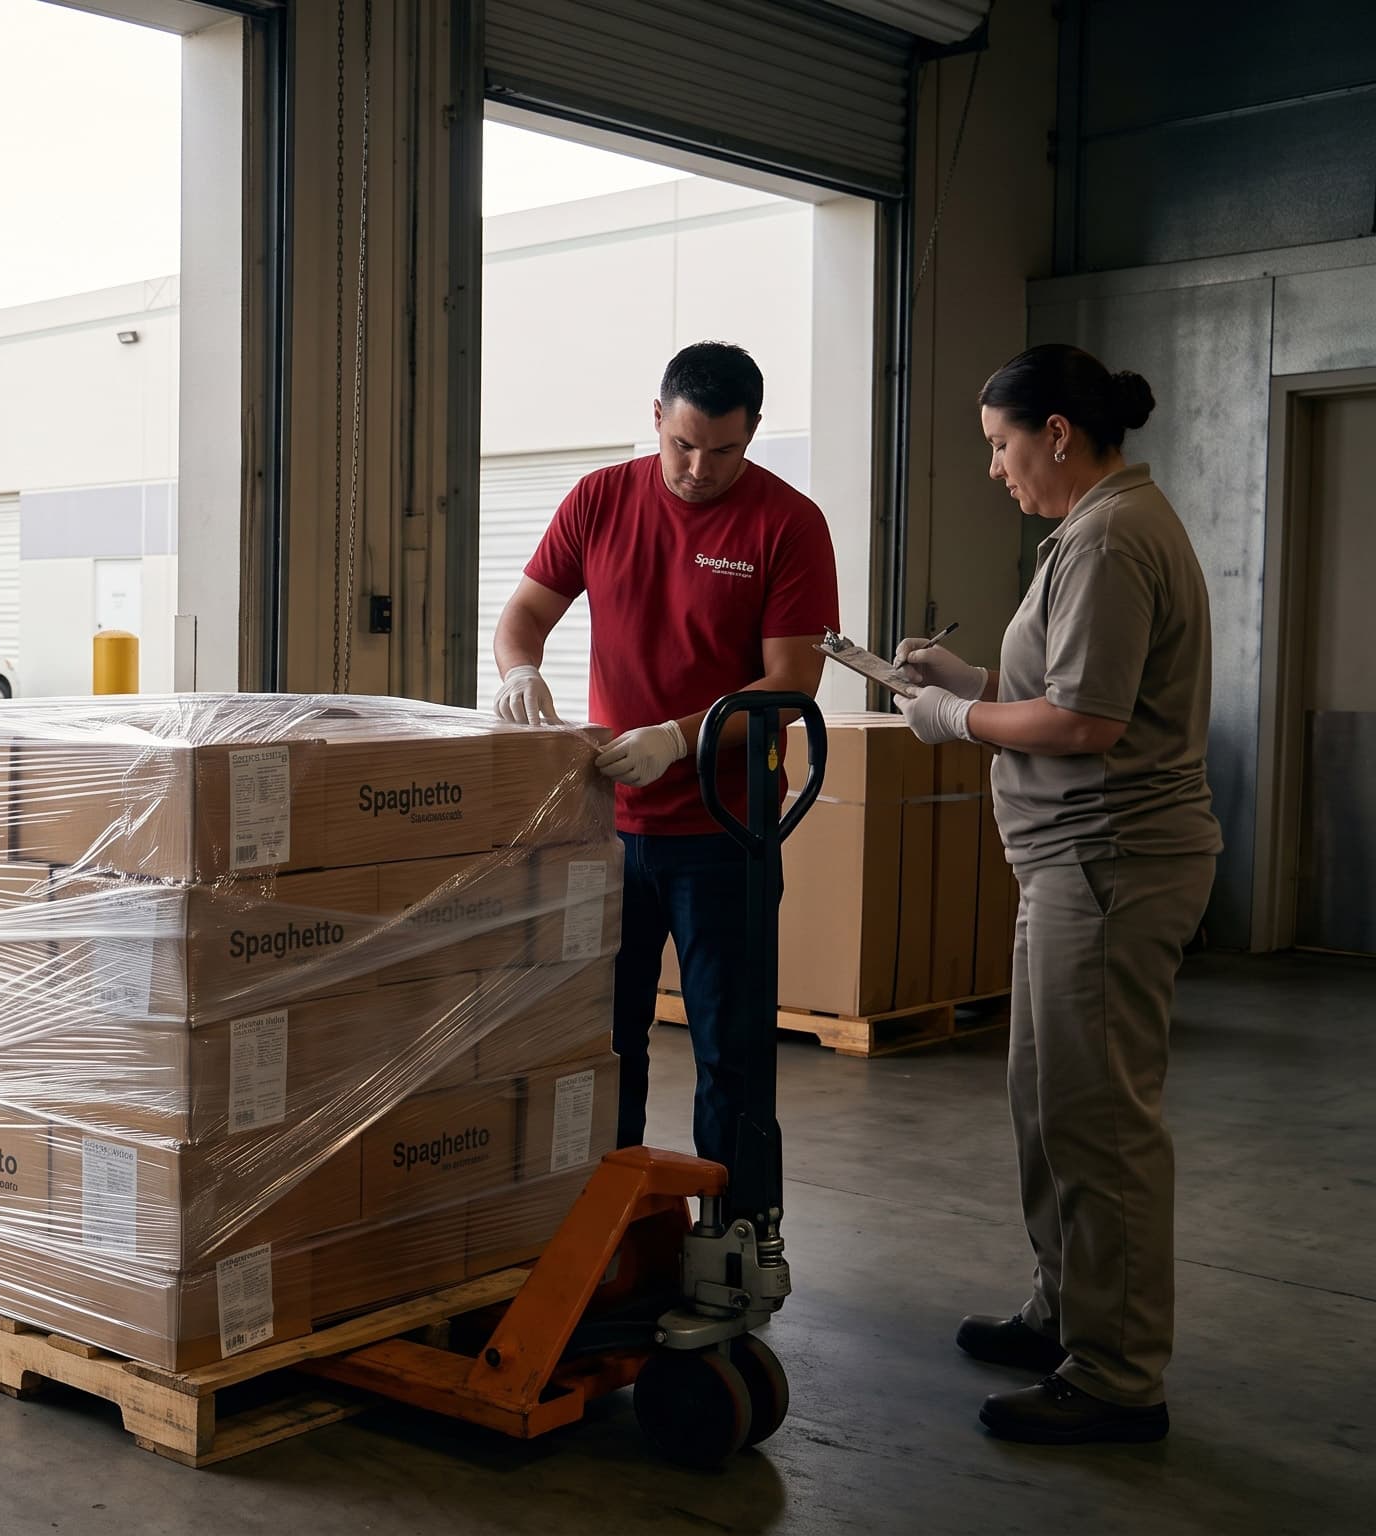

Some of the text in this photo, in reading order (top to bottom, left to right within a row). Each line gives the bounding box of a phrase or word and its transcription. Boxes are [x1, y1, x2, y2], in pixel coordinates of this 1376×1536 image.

[694, 553, 755, 573] Spaghetto
[358, 781, 462, 817] Spaghetto
[229, 920, 344, 964] Spaghetto
[392, 1126, 490, 1172] Spaghetto
